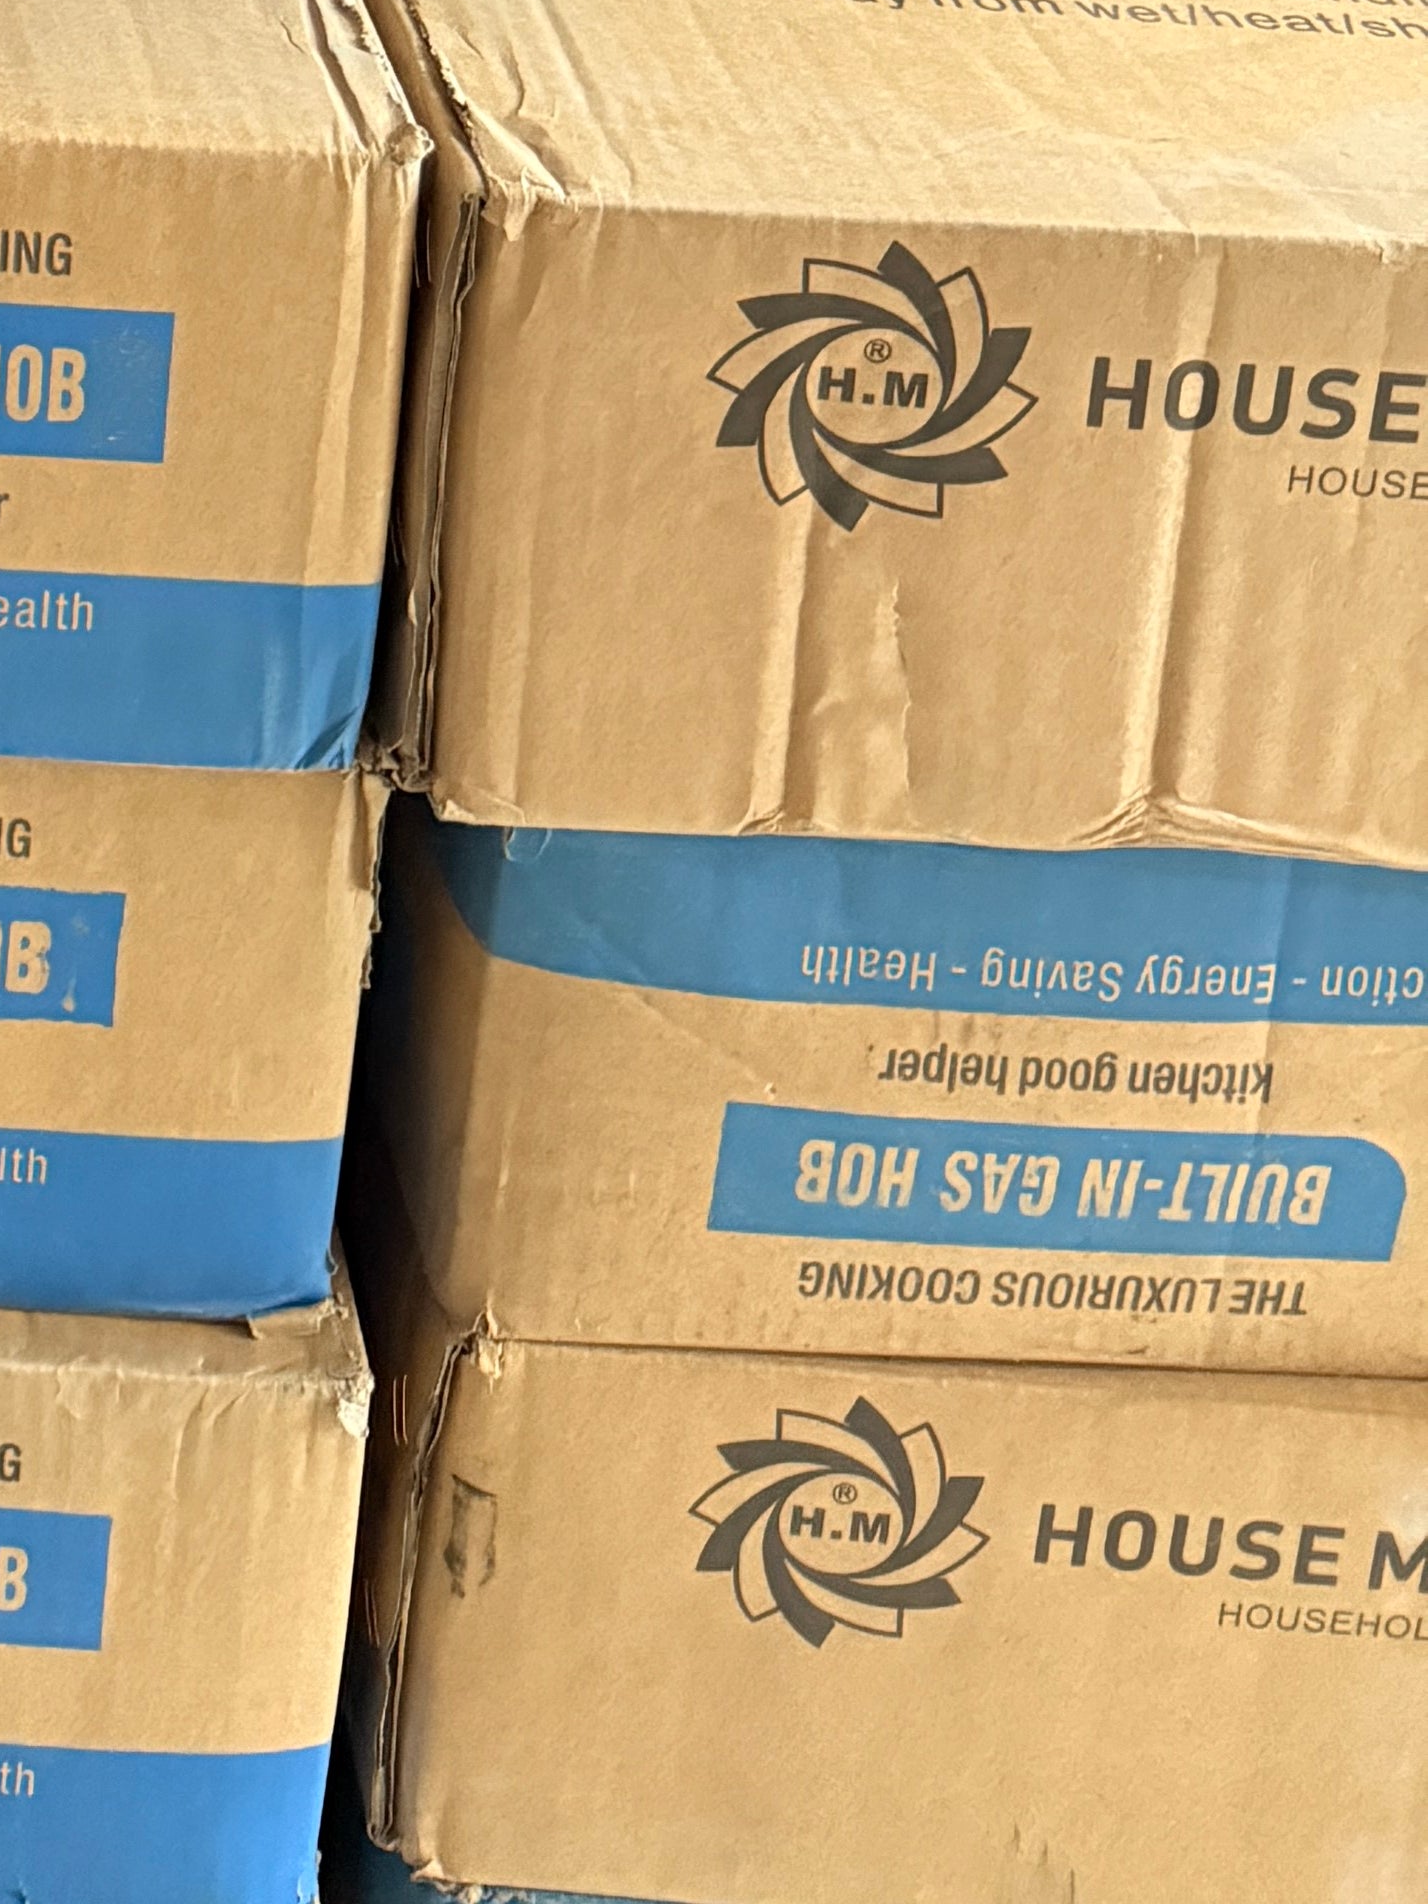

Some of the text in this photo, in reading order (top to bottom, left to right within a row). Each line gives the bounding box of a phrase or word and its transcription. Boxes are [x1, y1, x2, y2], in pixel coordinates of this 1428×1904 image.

[1085, 355, 1428, 445] HOUSE
[800, 944, 938, 993] Health
[980, 946, 1123, 1003] Saving
[1136, 952, 1277, 1006] Energy
[877, 1044, 1275, 1106] kitchen good helper
[794, 1138, 1332, 1227] BUILT-IN GAS HOB
[798, 1259, 1308, 1317] THE LUXURIOUS COOKING
[1033, 1502, 1345, 1587] HOUSE
